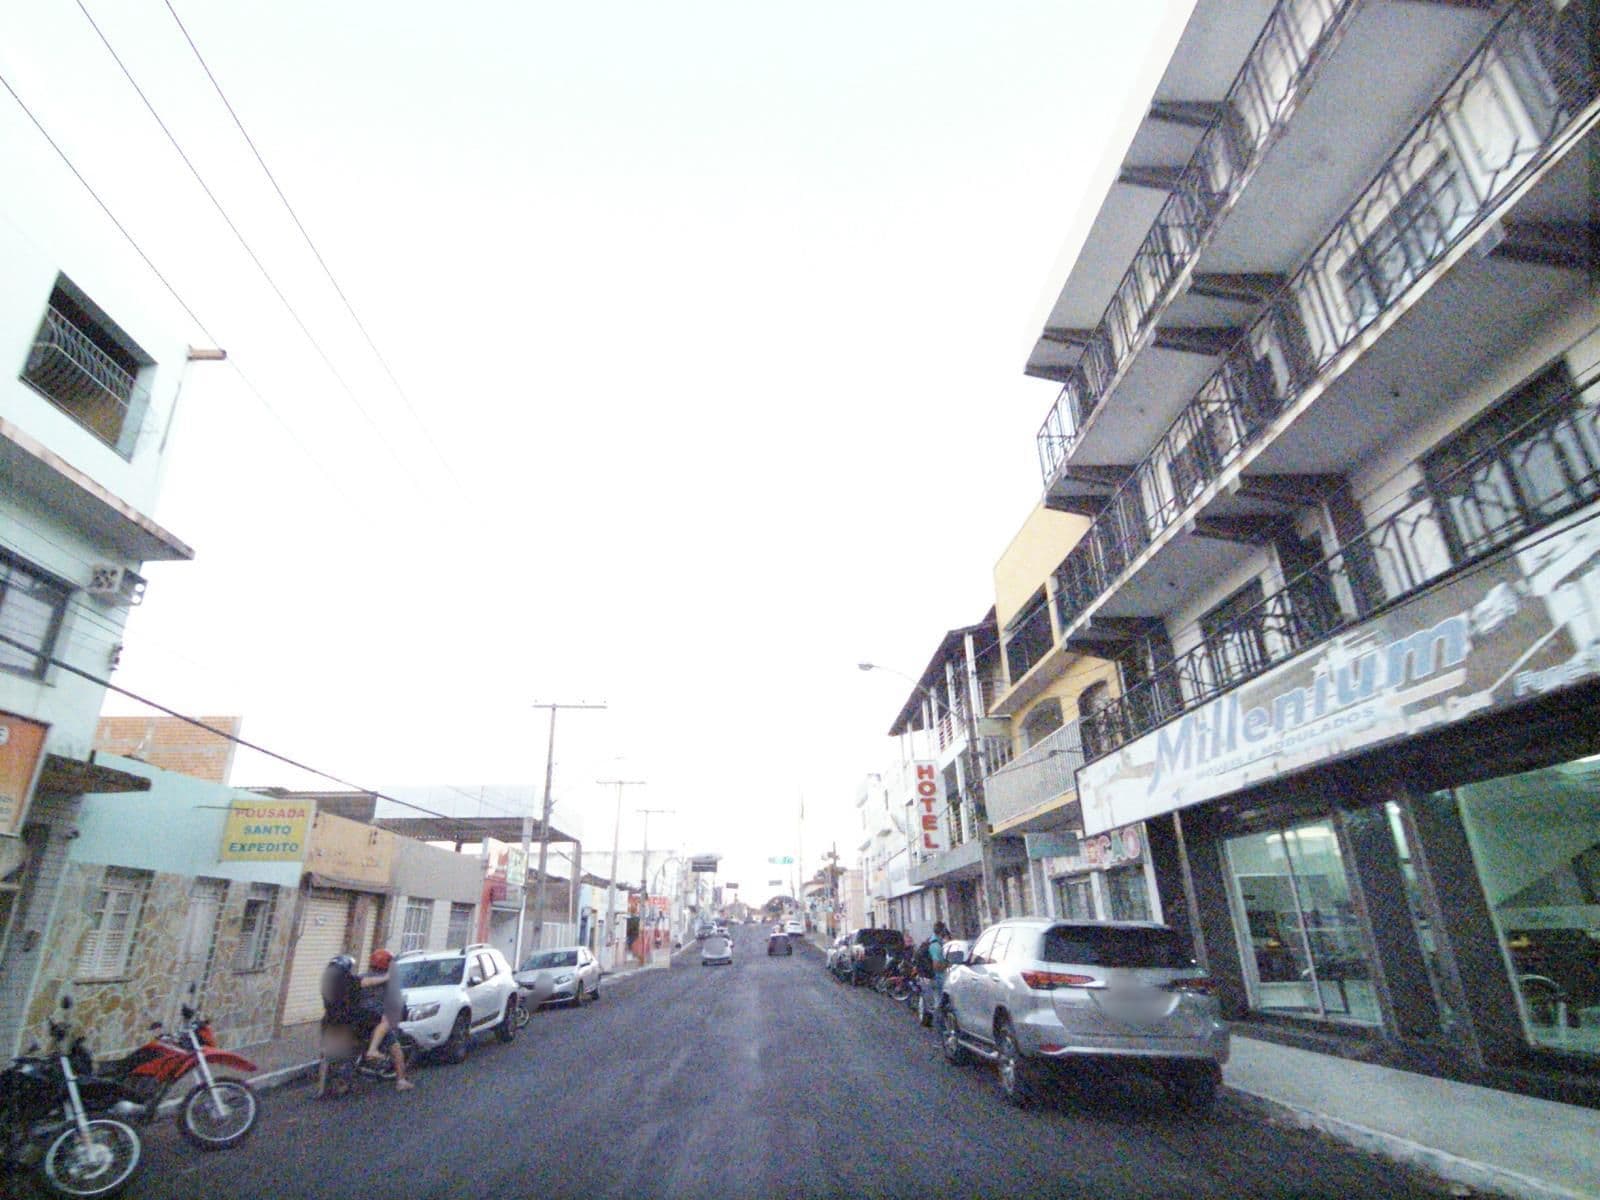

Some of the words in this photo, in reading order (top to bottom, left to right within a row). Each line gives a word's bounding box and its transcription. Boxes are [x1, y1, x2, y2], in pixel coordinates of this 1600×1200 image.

[1147, 614, 1468, 796] Millenium
[917, 764, 939, 849] HOTEL
[234, 807, 305, 818] POUSADA
[243, 824, 292, 835] SANTO
[228, 842, 299, 853] EXPEDITO
